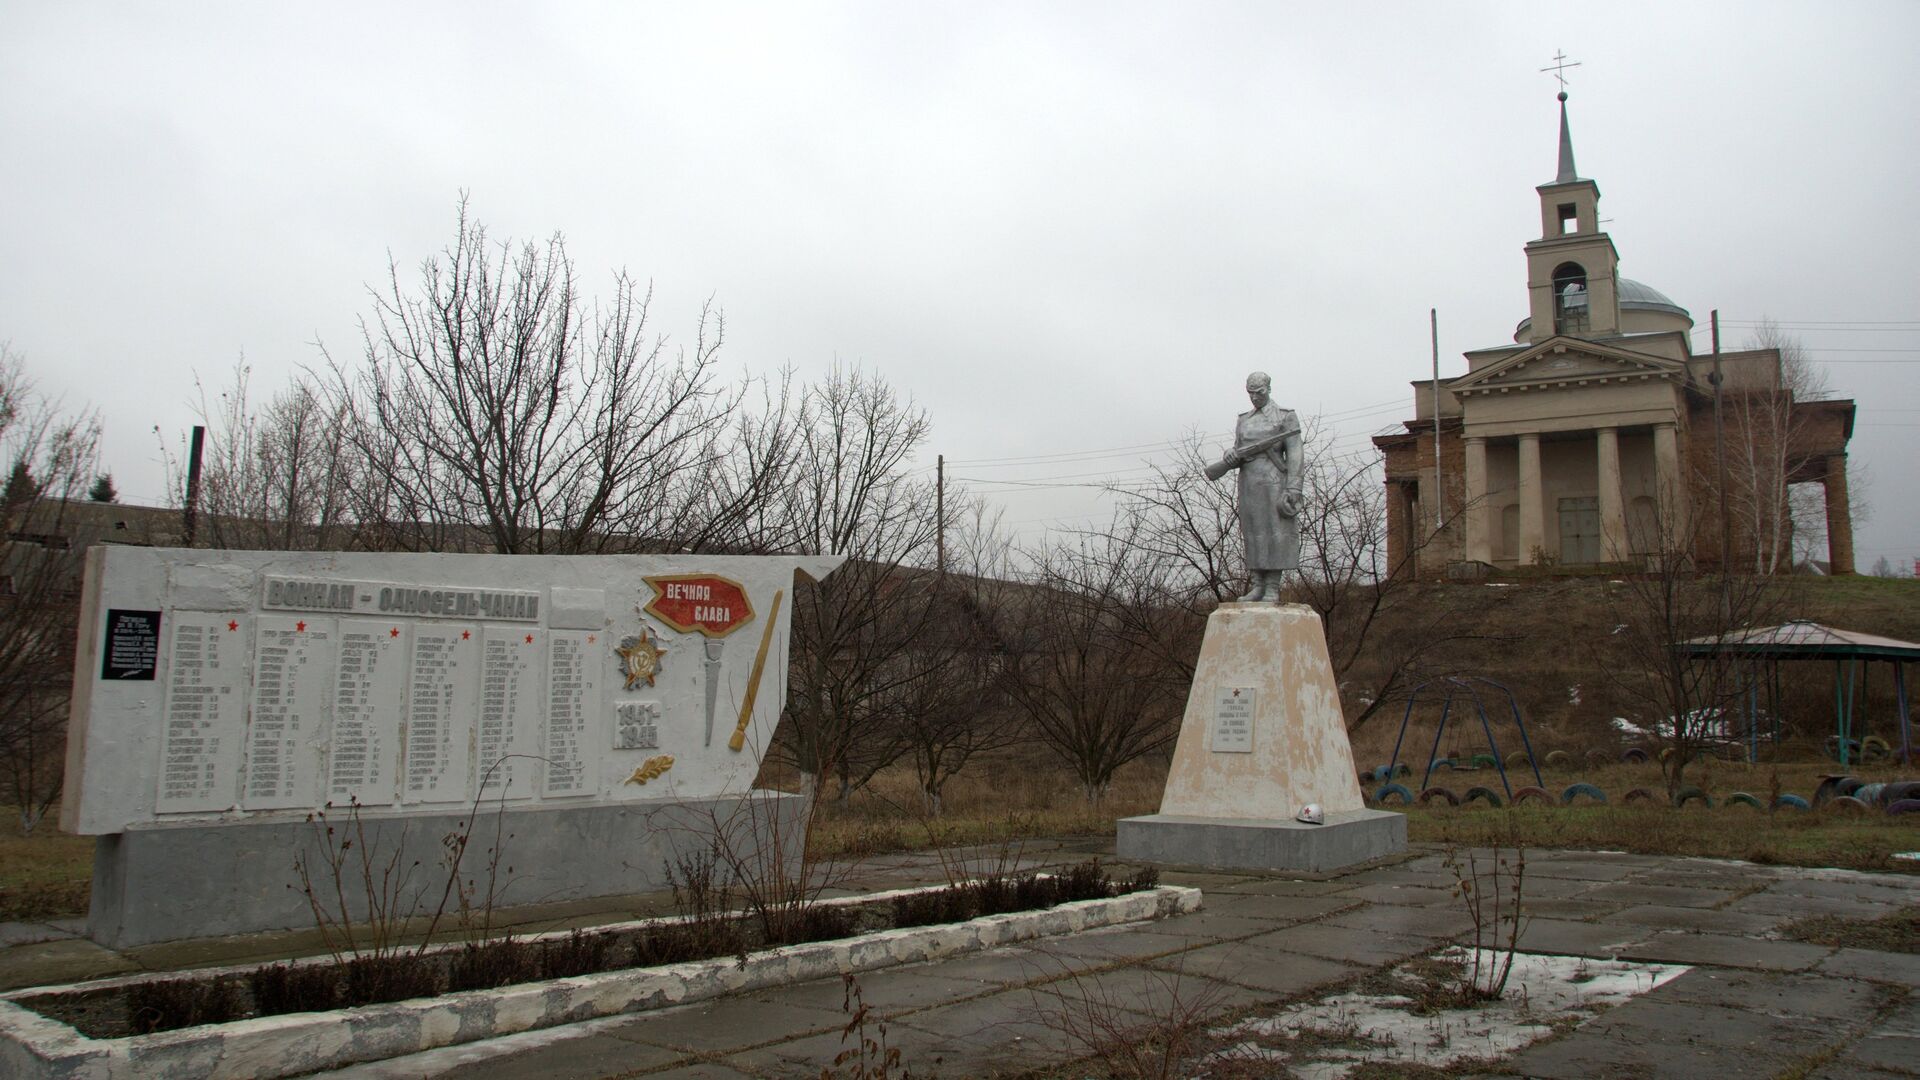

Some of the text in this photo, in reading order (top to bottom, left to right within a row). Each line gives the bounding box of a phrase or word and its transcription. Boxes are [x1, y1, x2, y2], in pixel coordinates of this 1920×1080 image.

[667, 583, 710, 601] ВЕЧНАЯ
[694, 605, 730, 622] СЛАВА
[619, 726, 658, 748] 1945
